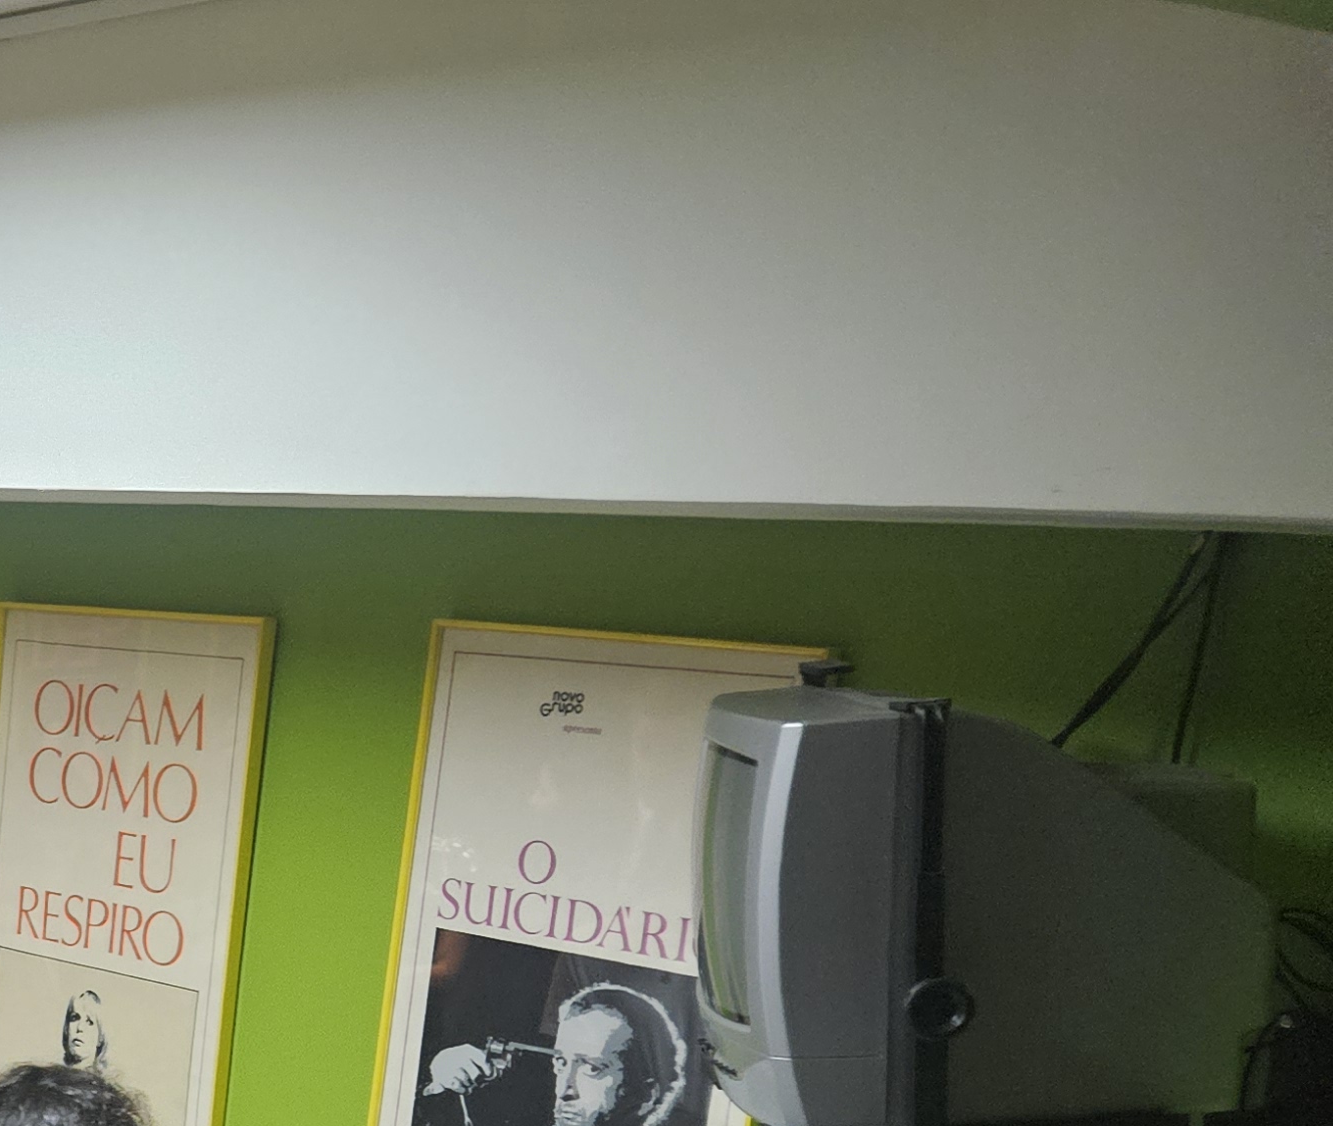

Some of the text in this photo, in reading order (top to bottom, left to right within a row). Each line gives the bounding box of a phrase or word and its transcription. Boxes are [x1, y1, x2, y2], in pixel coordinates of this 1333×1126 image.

[34, 679, 205, 751] OIÇAM
[551, 690, 585, 703] novo
[28, 746, 198, 824] COMO
[113, 830, 177, 894] EU
[517, 839, 558, 885] O
[16, 885, 185, 967] RESPIRO
[436, 877, 698, 963] SUICIDÁRI
